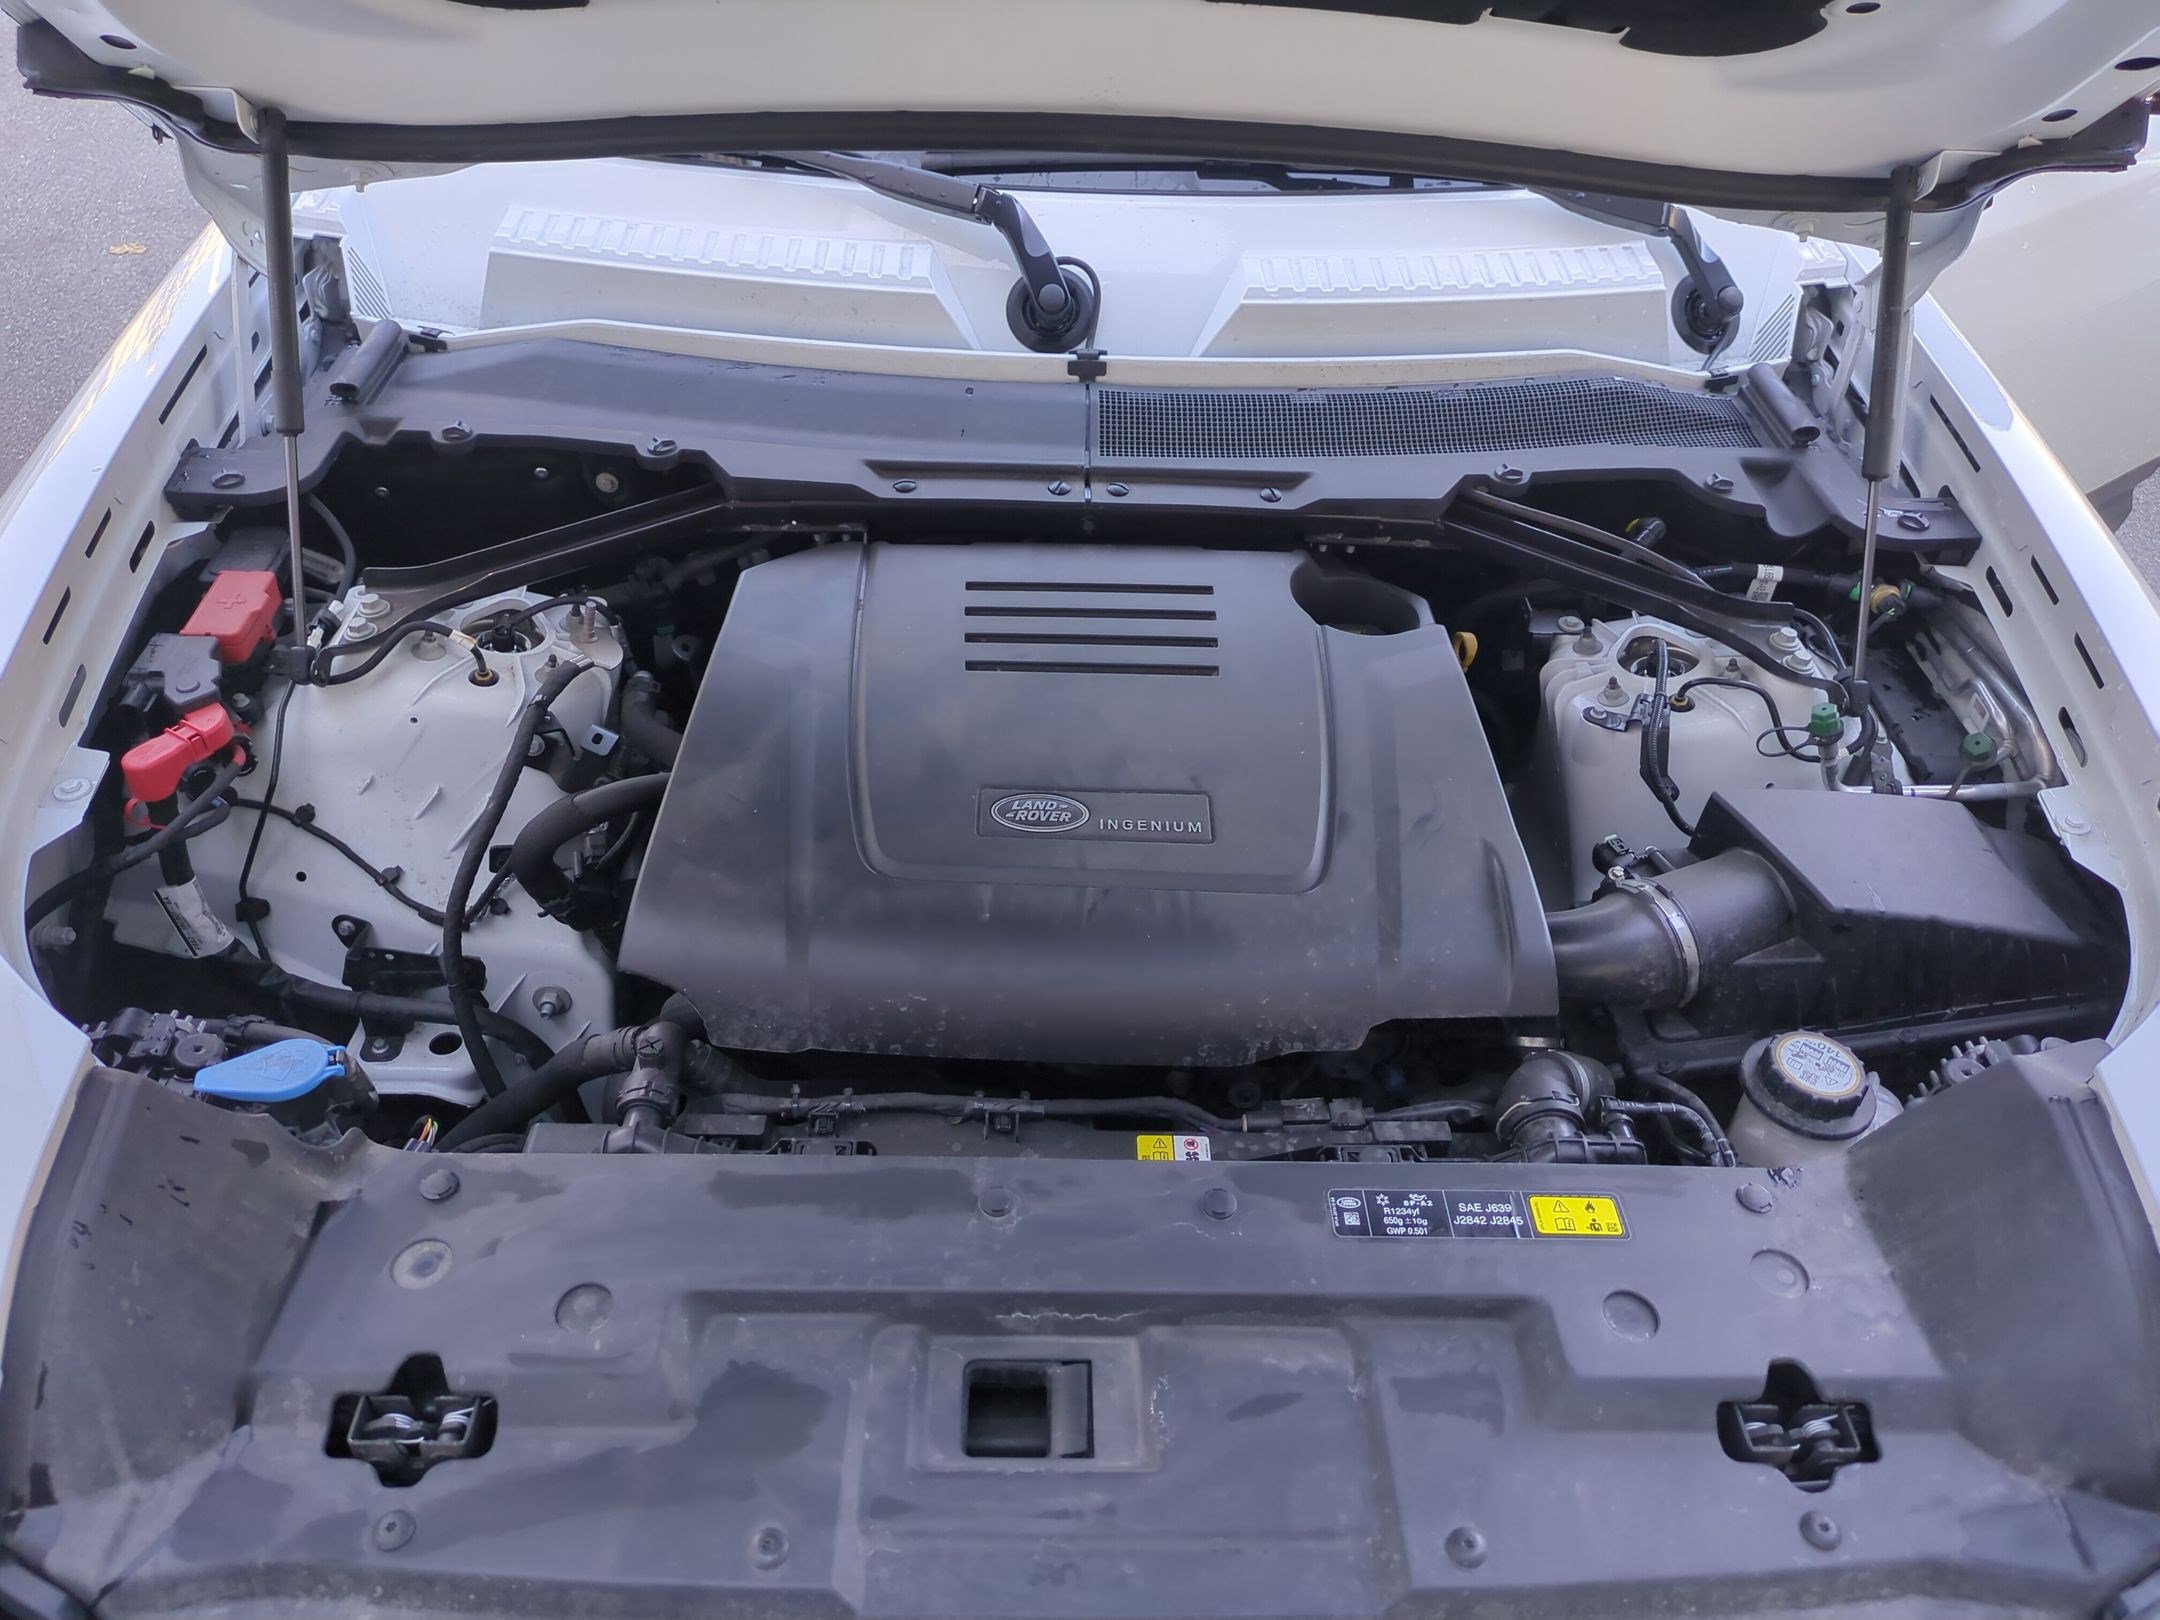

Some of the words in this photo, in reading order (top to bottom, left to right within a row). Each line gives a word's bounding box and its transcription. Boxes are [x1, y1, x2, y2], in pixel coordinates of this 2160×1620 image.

[1012, 800, 1057, 810] LAND
[1015, 811, 1072, 822] ROVER
[1099, 818, 1202, 833] INGENIUM
[1383, 1207, 1420, 1216] R1234yf
[1458, 1202, 1483, 1212] SAE
[1485, 1203, 1512, 1213] J639
[1383, 1216, 1403, 1226] 650g
[1453, 1215, 1488, 1225] J2842
[1490, 1216, 1524, 1225] J2845
[1386, 1226, 1407, 1235] GWP
[1407, 1227, 1428, 1236] 0.501
